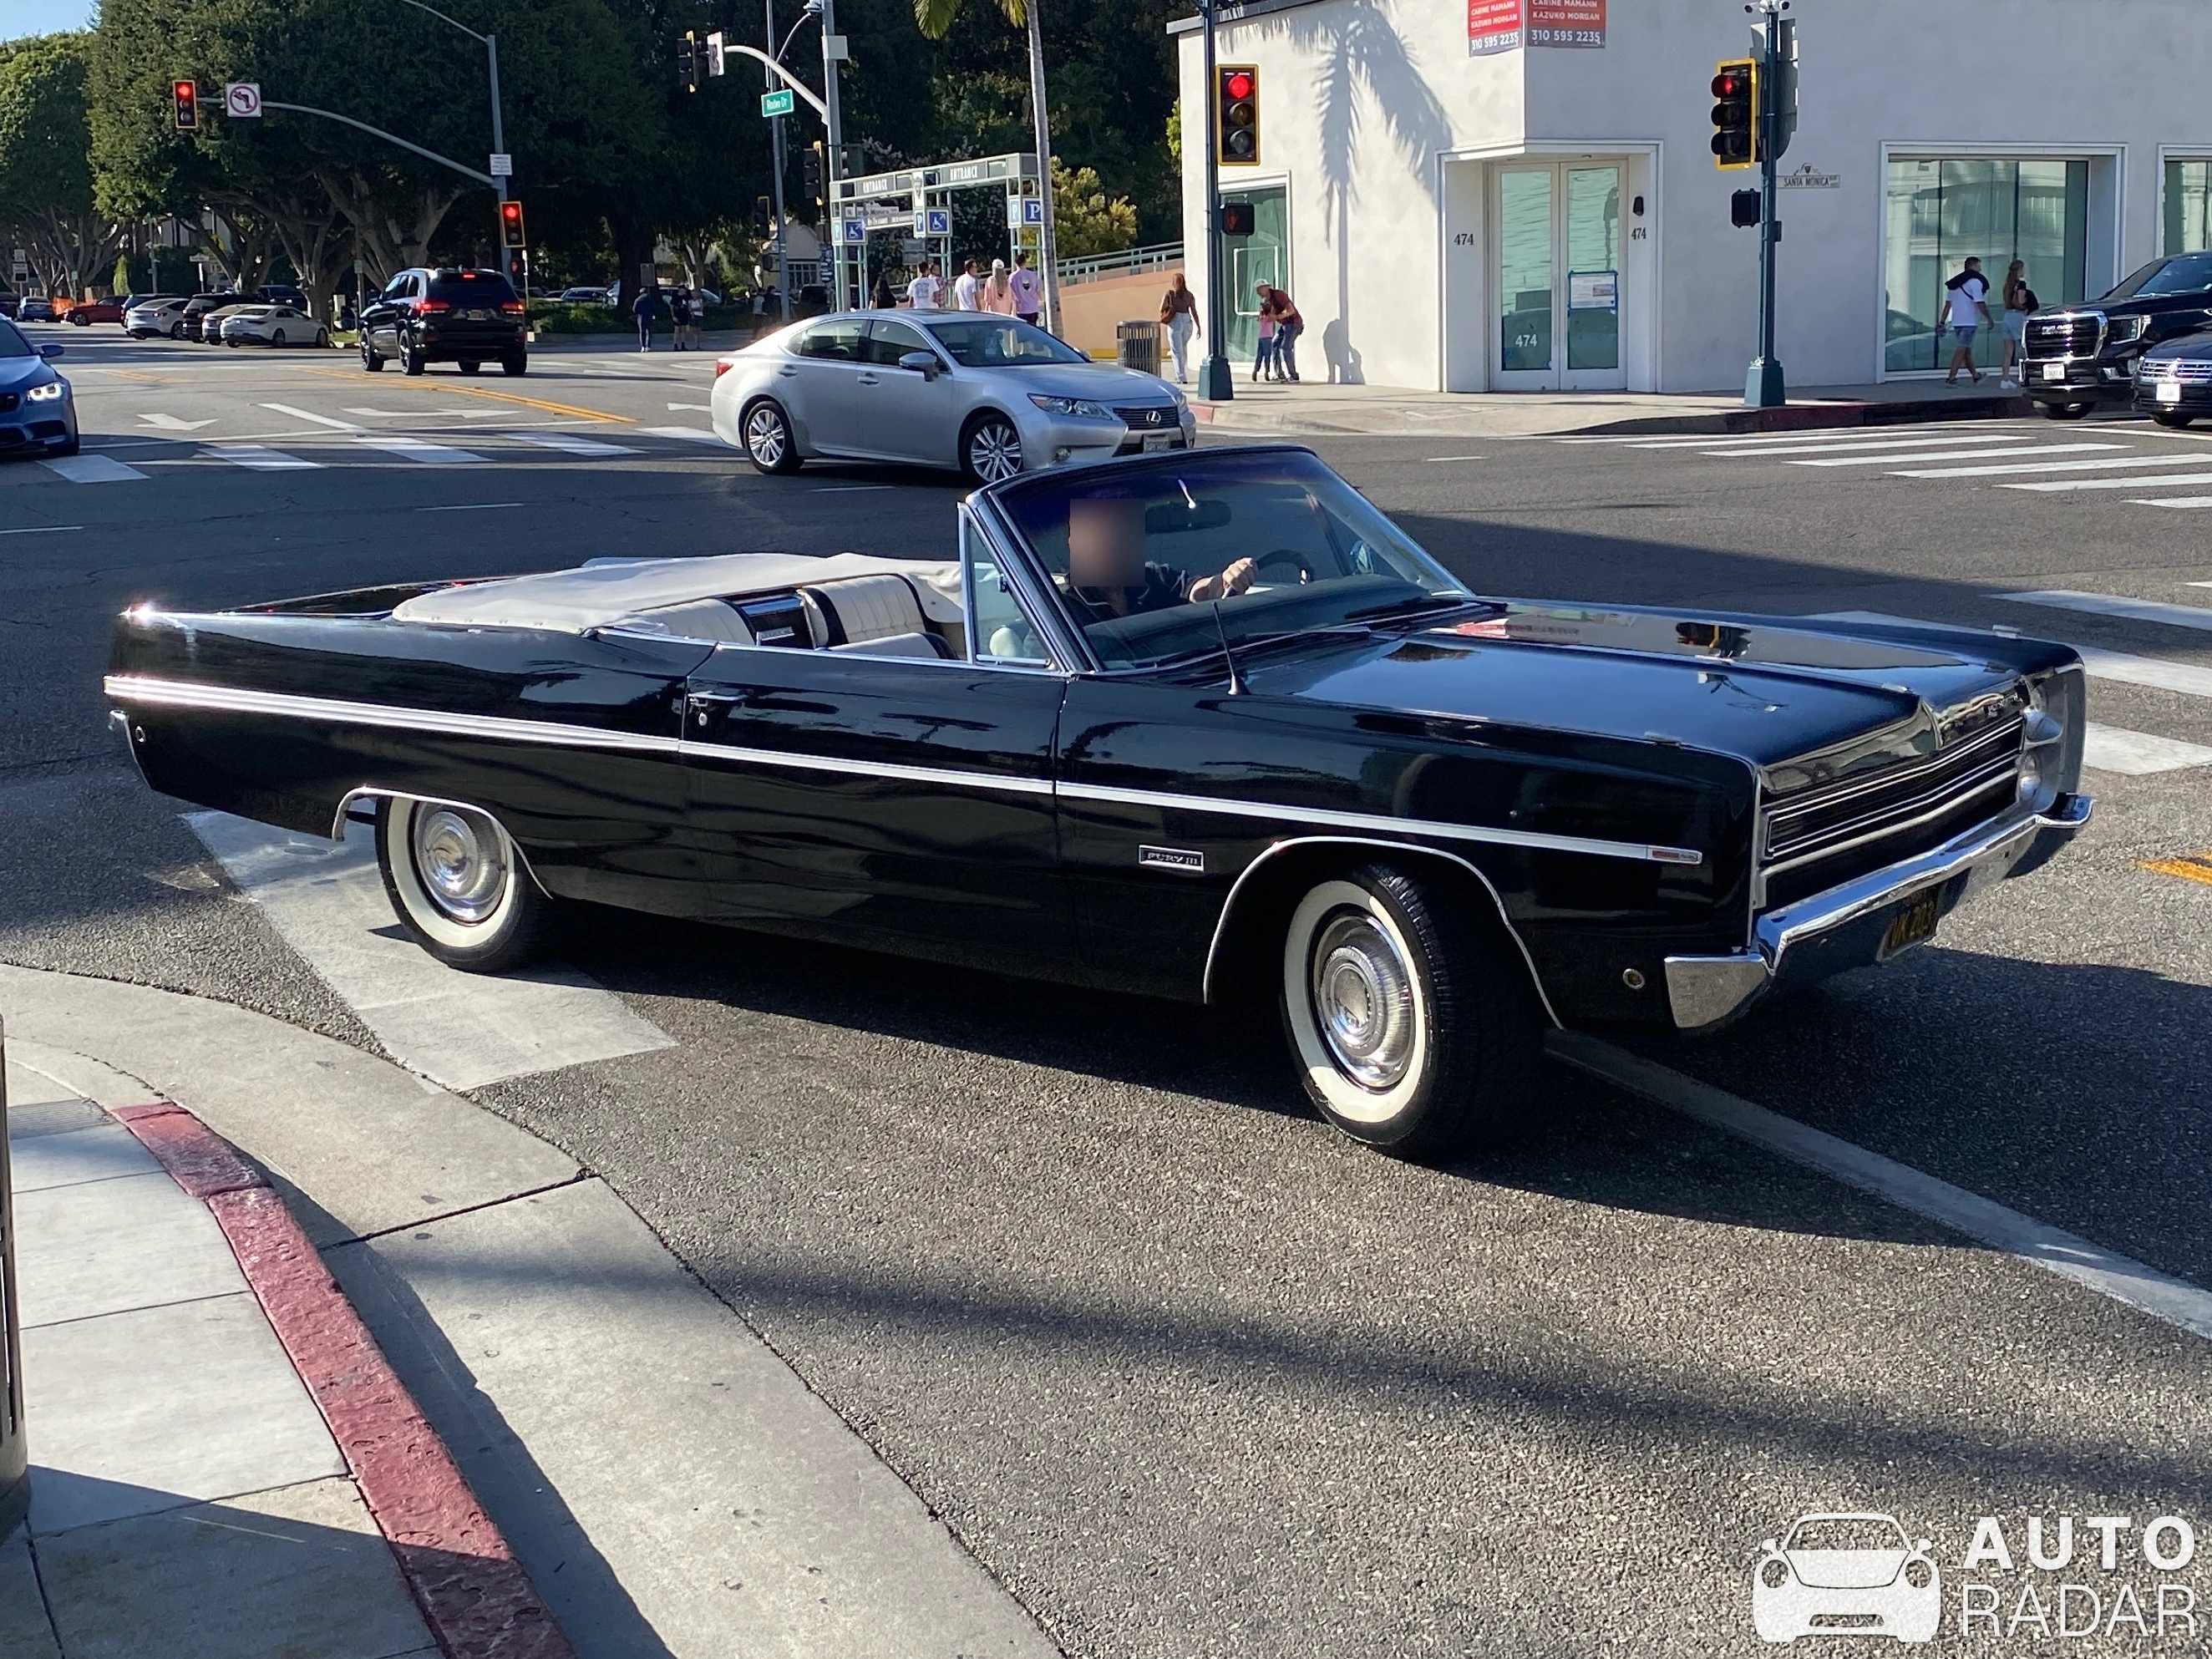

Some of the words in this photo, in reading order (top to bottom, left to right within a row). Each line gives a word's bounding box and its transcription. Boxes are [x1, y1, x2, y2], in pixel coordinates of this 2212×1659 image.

[1471, 5, 1489, 16] CARINE
[1532, 11, 1565, 20] KAZUKO
[1567, 13, 1601, 21] MORGAN
[1471, 18, 1492, 28] KAZUKO
[1493, 13, 1517, 24] MORGAN
[1471, 38, 1483, 50] 310
[1484, 35, 1498, 48] 595
[1499, 32, 1519, 45] 2235
[1531, 29, 1550, 41] 310
[1554, 30, 1573, 42] 595
[1575, 31, 1601, 43] 2235
[950, 165, 978, 181] ENTRANCE
[863, 178, 888, 194] ENTRANCE
[1783, 176, 1803, 187] SANTA
[1805, 176, 1829, 186] MONICA
[1029, 203, 1041, 220] P
[1454, 234, 1474, 246] 474
[1631, 227, 1647, 240] 474
[1514, 334, 1538, 348] 474
[1147, 852, 1184, 863] FURY
[1185, 857, 1199, 865] III
